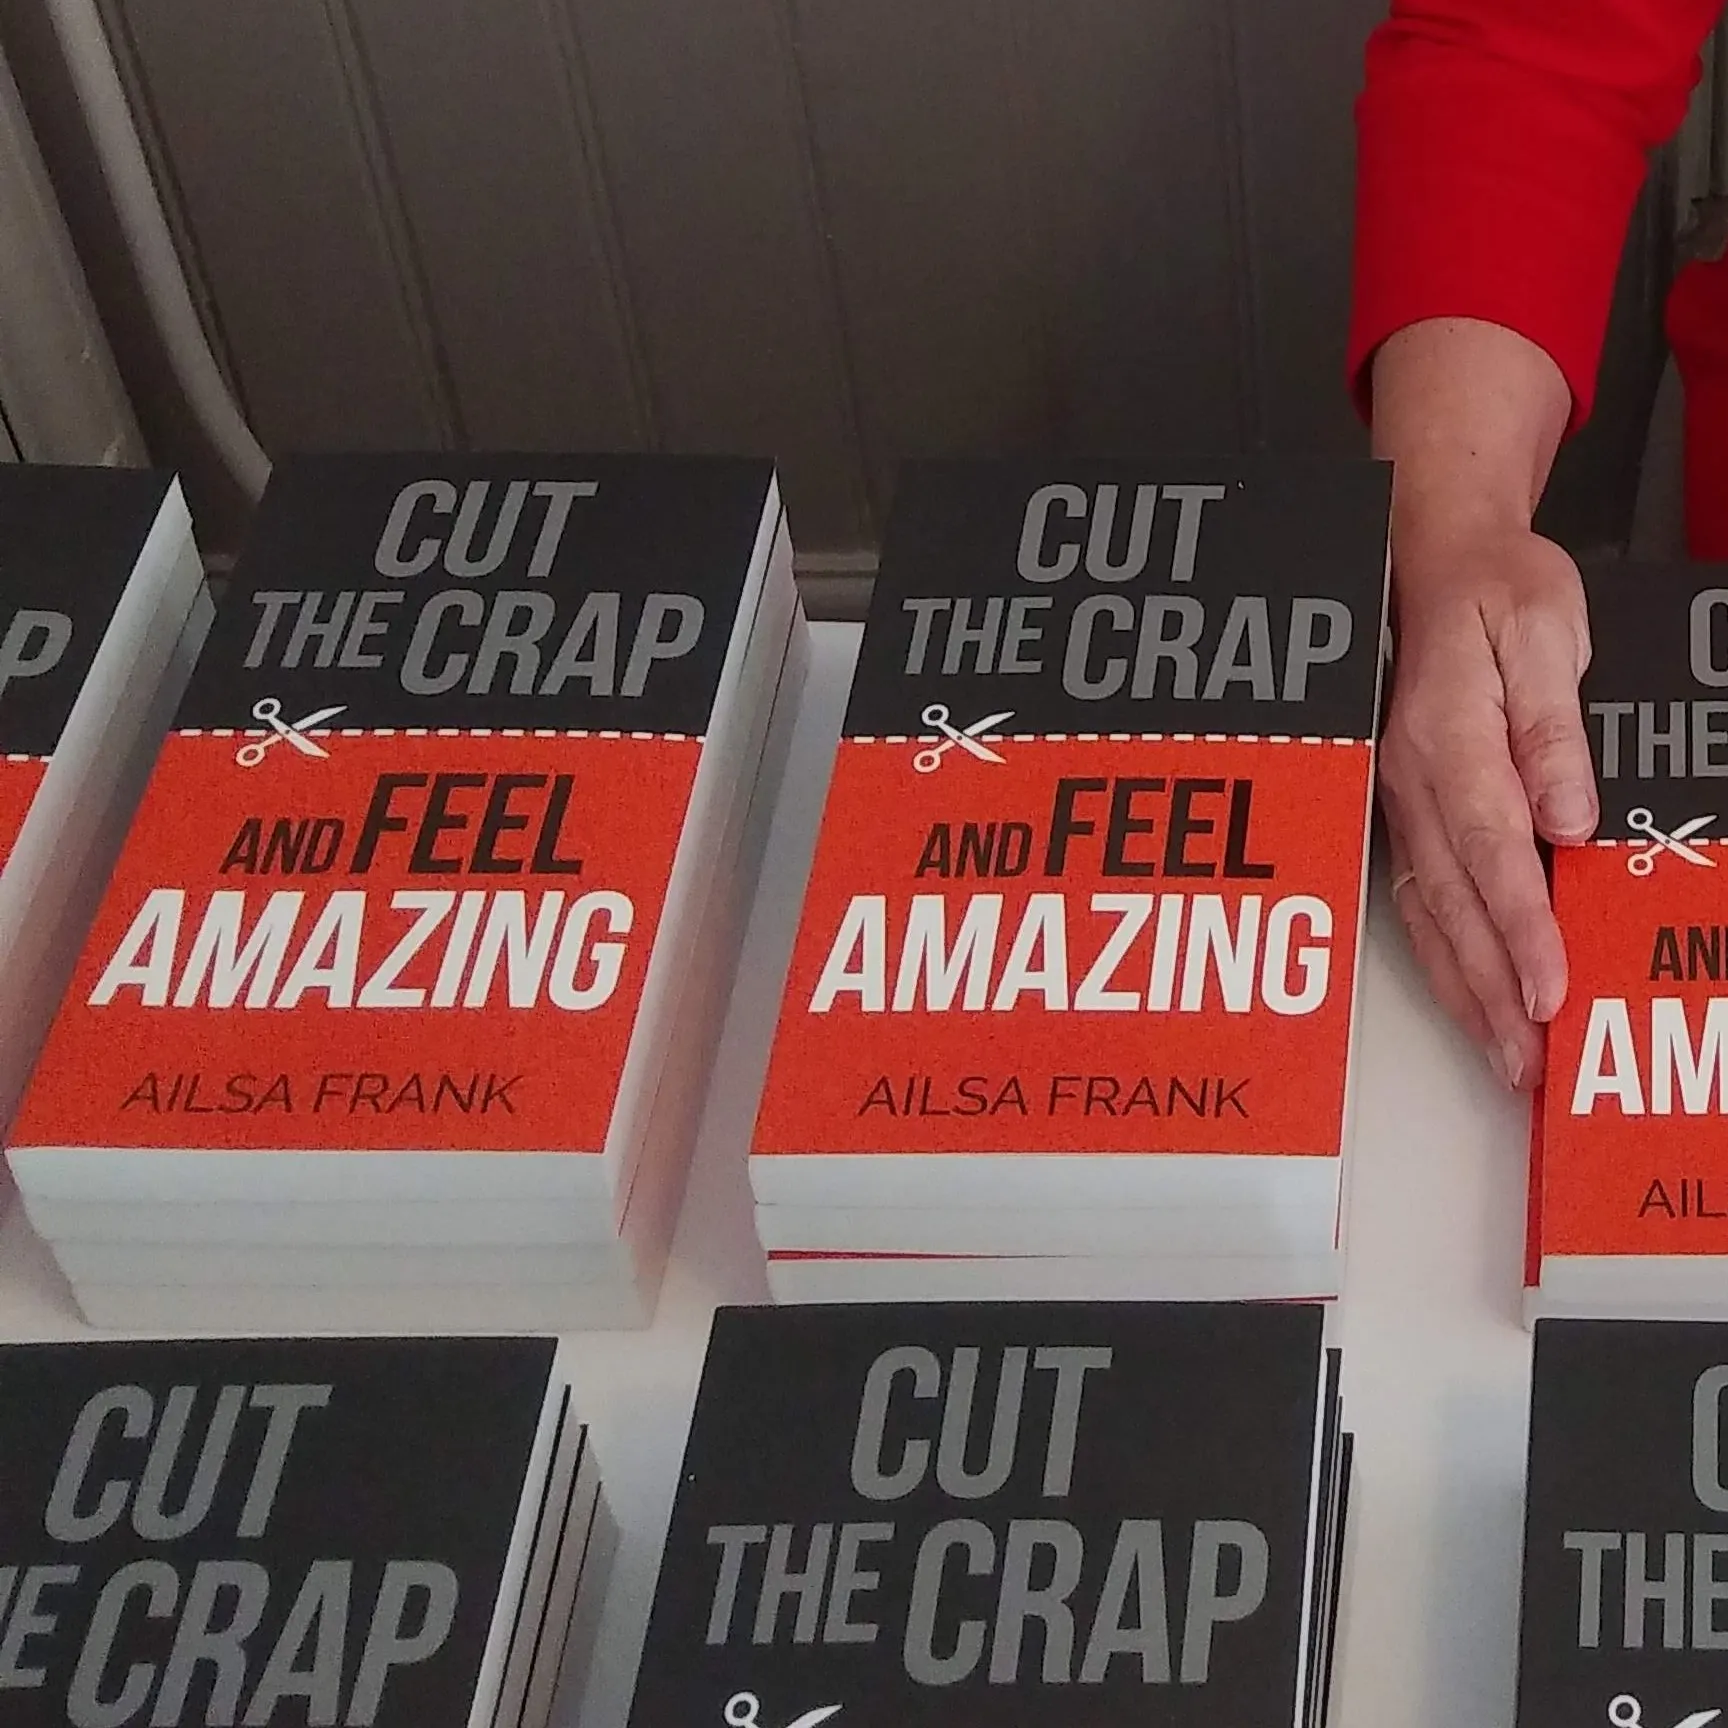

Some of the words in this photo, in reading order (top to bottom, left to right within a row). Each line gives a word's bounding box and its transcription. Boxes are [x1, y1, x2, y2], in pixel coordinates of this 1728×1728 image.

[373, 479, 600, 579] CUT
[1015, 482, 1227, 584] CUT
[242, 591, 404, 669] THE
[400, 589, 706, 697] CRAP
[901, 596, 1053, 676] THE
[1060, 593, 1354, 702] CRAP
[219, 817, 345, 873] AND
[348, 773, 584, 875] FEEL
[914, 822, 1032, 877] AND
[1043, 777, 1275, 880] FEEL
[88, 889, 635, 1011] AMAZING
[808, 893, 1334, 1016] AMAZING
[120, 1073, 294, 1114] AILSA
[312, 1074, 524, 1115] FRANK
[857, 1076, 1028, 1117] AILSA
[1047, 1077, 1250, 1118] FRANK
[43, 1383, 334, 1543] CUT
[850, 1345, 1113, 1501] CUT
[65, 1559, 459, 1728] CRAP
[704, 1522, 895, 1646] THE
[902, 1518, 1270, 1686] CRAP
